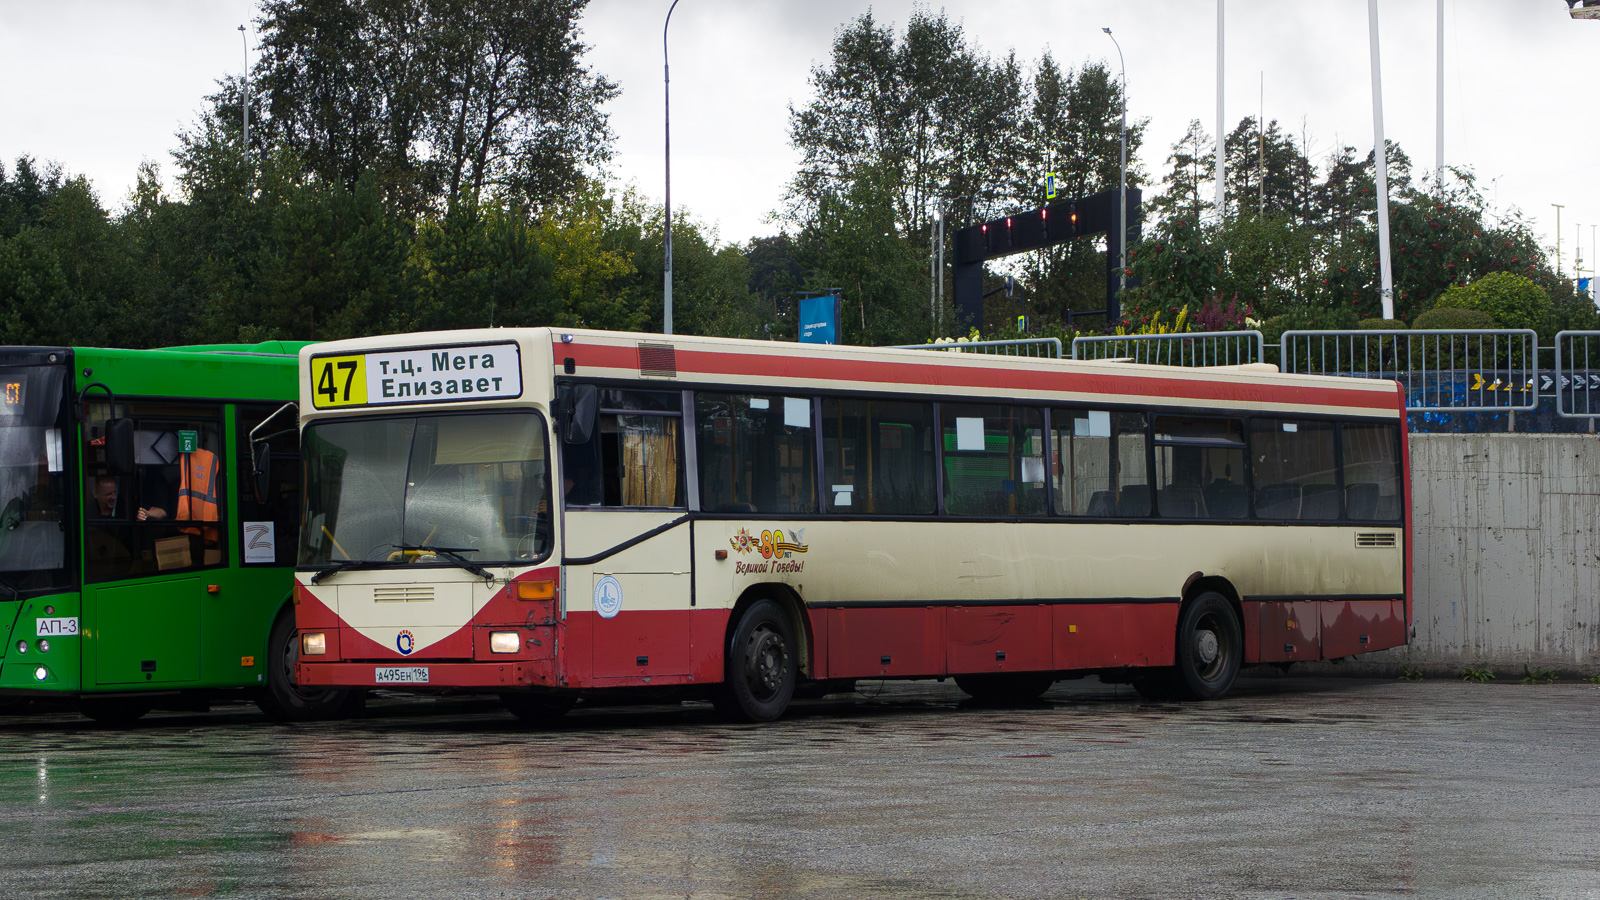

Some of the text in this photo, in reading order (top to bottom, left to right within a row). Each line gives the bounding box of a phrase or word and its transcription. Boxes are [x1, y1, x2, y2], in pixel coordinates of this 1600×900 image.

[432, 351, 495, 371] Мега
[318, 360, 358, 402] 47
[382, 377, 503, 398] Елизавет
[761, 529, 784, 559] 80
[735, 561, 769, 576] Великой
[39, 619, 77, 634] АП-3
[378, 669, 427, 681] А495ЕН 196
